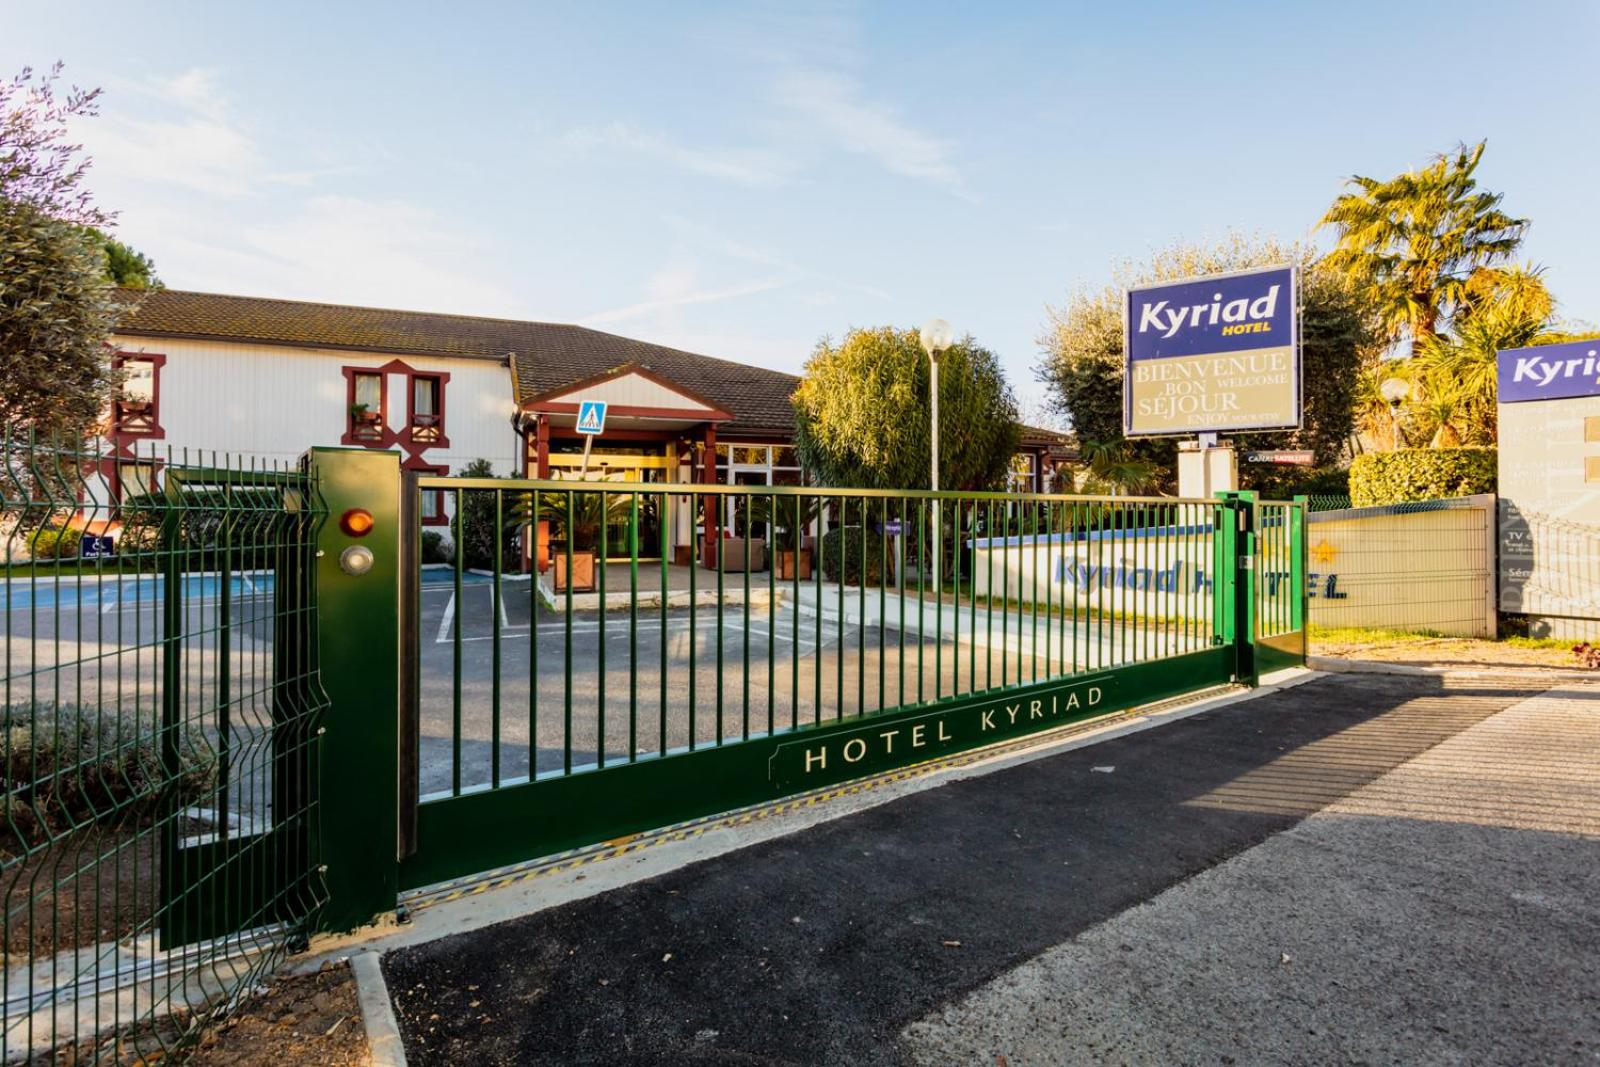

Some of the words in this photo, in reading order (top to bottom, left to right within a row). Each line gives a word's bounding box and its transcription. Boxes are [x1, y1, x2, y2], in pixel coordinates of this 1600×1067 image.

[1139, 285, 1281, 339] Kyriad
[1222, 321, 1272, 336] HOTEL
[1136, 352, 1286, 383] BIENVENUE
[1217, 373, 1288, 388] WELCOME
[1513, 350, 1600, 387] Kyri
[1166, 380, 1207, 396] BON
[1139, 392, 1240, 420] SÉJOUR
[1187, 413, 1230, 426] ENJOY
[1509, 532, 1523, 540] TV
[1190, 569, 1347, 599] HTEL
[805, 721, 952, 772] HOTEL
[981, 687, 1102, 731] KYRIAD
